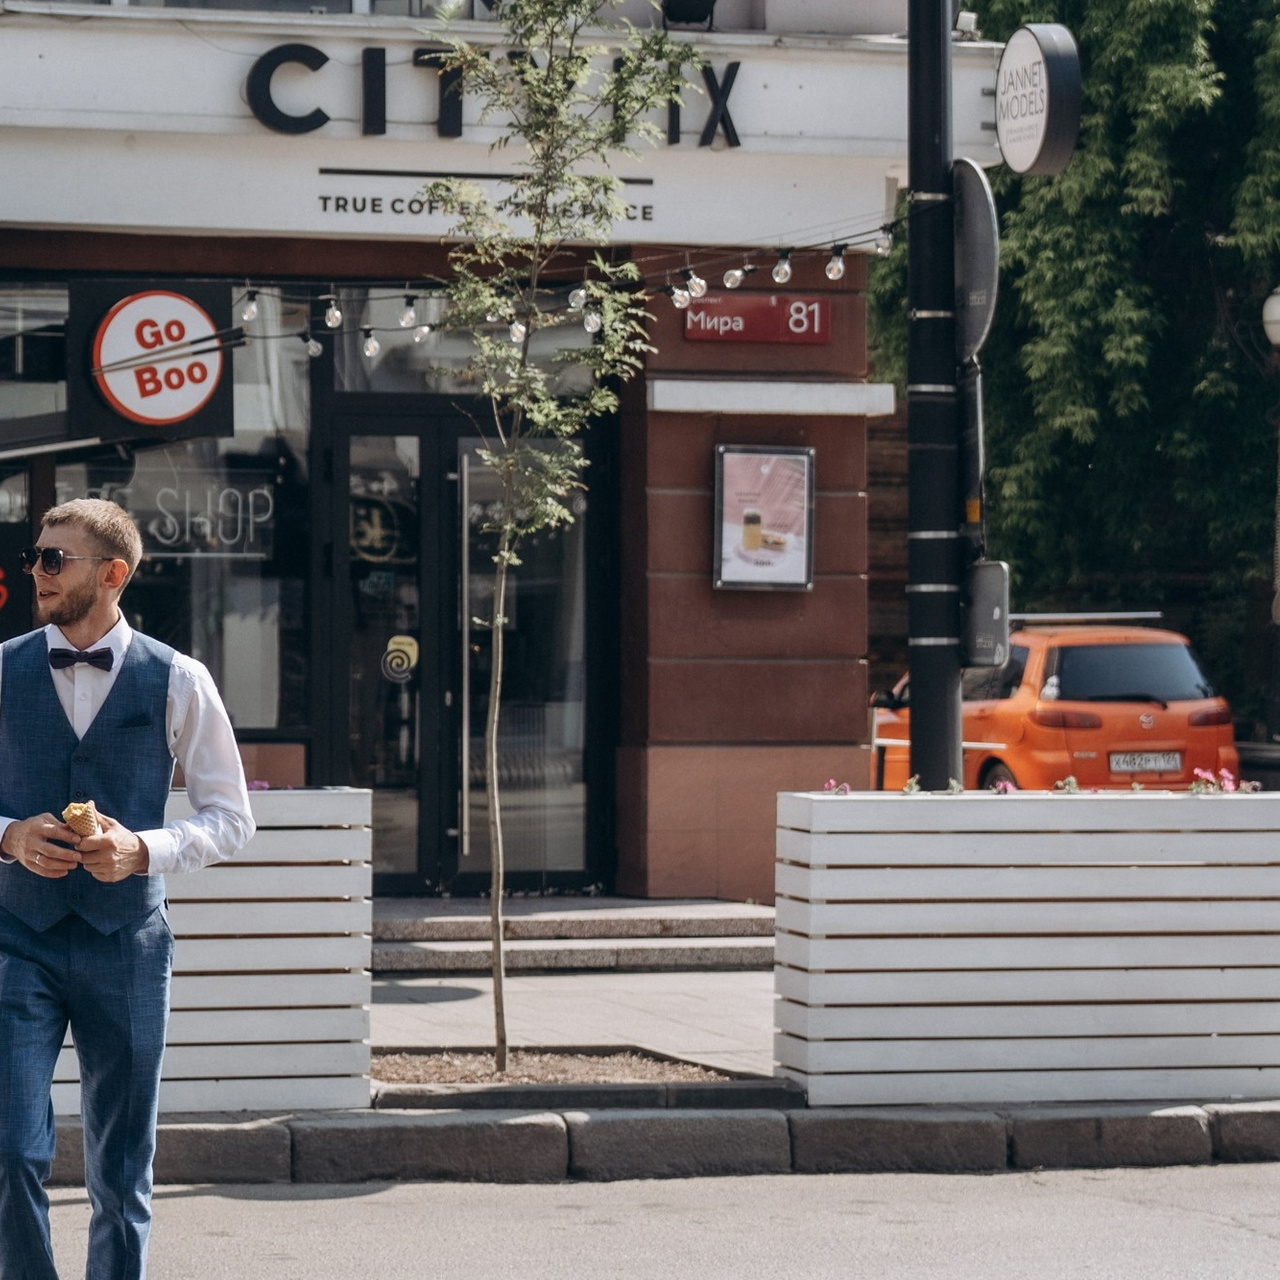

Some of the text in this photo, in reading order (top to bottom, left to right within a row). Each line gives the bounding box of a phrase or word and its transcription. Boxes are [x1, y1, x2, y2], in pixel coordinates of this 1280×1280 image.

[1000, 60, 1042, 97] JANNET
[999, 88, 1045, 121] MODELS
[319, 195, 383, 214] TRUE
[134, 318, 186, 350] Go
[686, 300, 820, 335] Мира 81
[133, 361, 208, 399] Boo
[155, 487, 274, 545] SHOP
